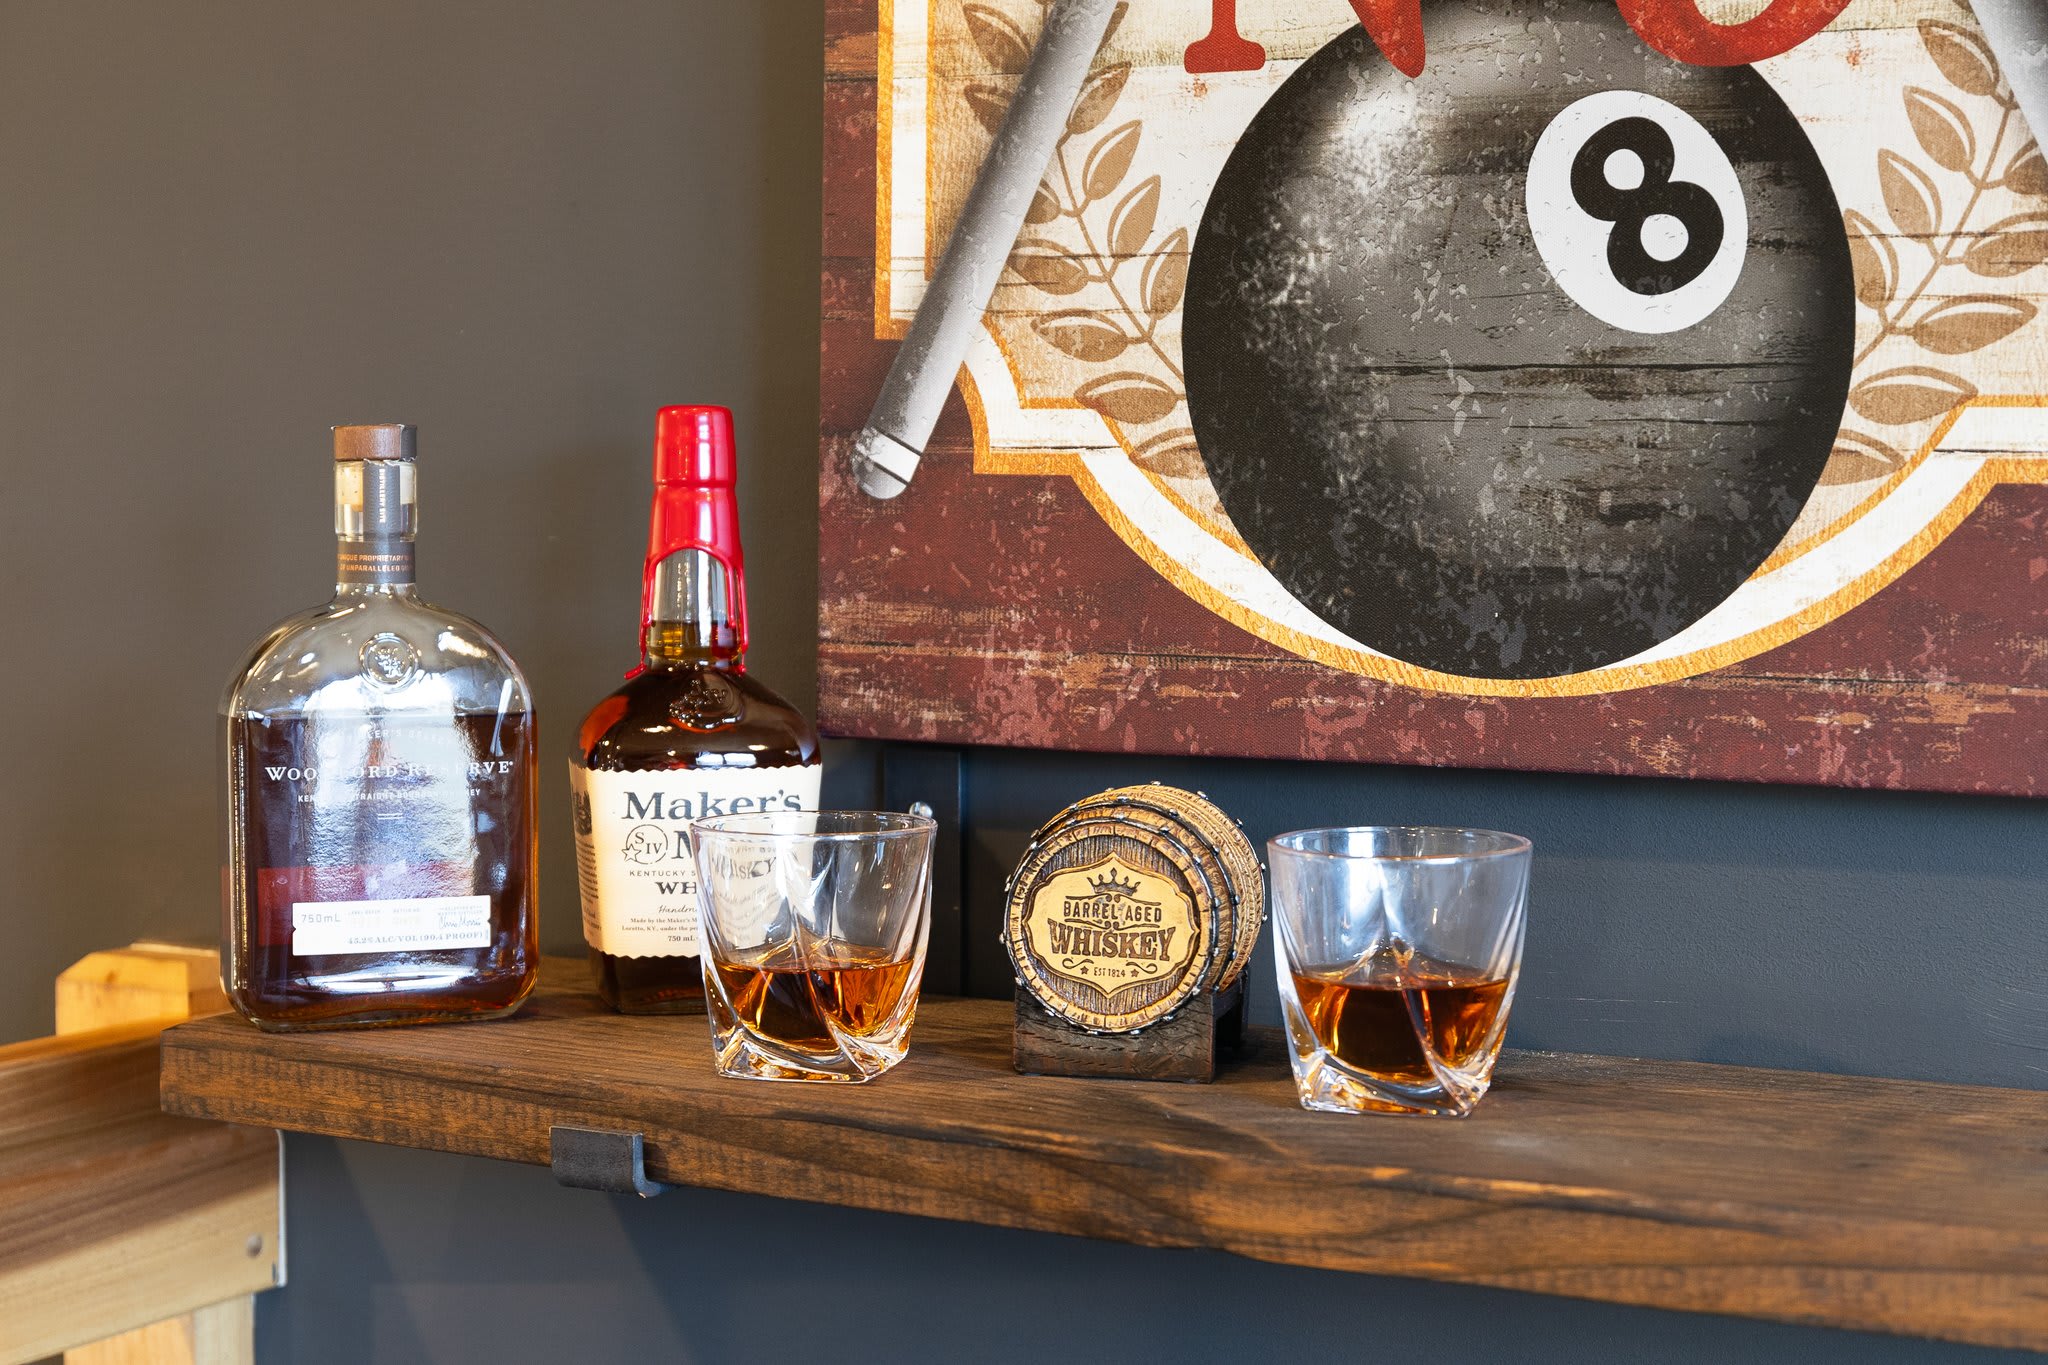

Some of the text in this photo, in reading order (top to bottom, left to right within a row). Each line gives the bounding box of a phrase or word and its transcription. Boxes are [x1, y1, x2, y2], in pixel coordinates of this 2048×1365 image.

[1570, 116, 1724, 296] 8
[621, 789, 801, 820] Maker's
[301, 914, 341, 923] 750mL
[1063, 901, 1162, 923] BARREL AGED
[1047, 917, 1177, 961] WHISKEY
[1094, 966, 1126, 978] EST 1824
